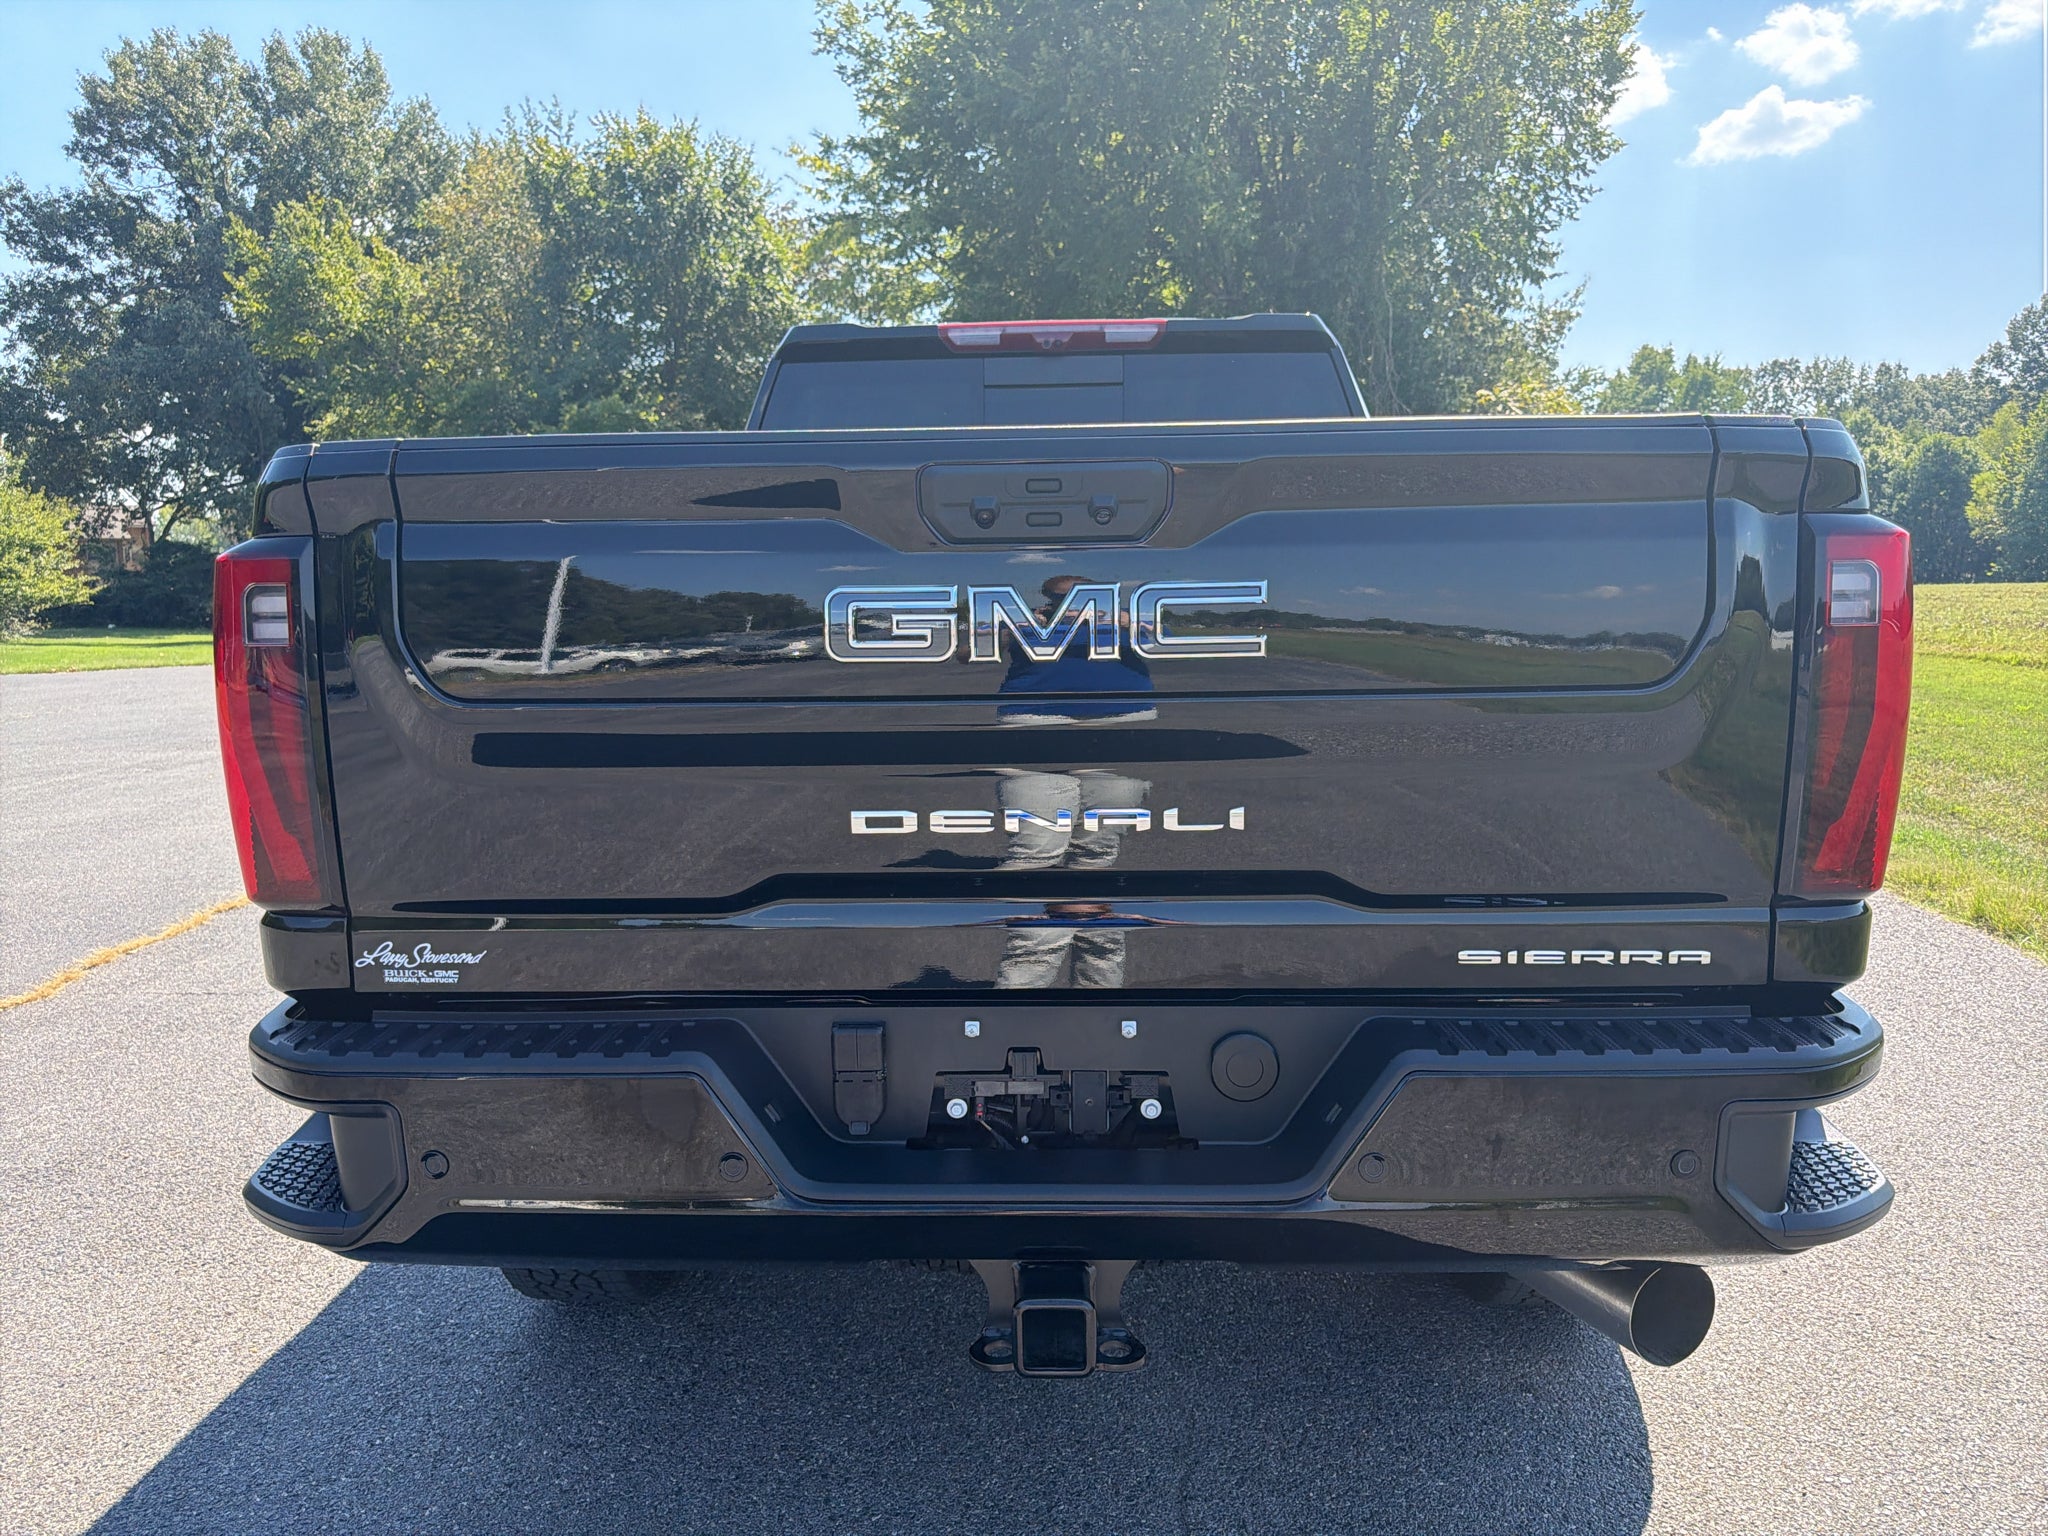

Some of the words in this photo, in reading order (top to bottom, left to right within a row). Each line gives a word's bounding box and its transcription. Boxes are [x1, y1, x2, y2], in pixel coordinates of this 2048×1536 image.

[824, 579, 1268, 664] GMC
[850, 806, 1246, 834] DENALI
[354, 941, 408, 968] Larry
[406, 943, 488, 968] Stovesand
[1457, 950, 1712, 966] SIERRA
[384, 969, 427, 978] BUICK
[433, 970, 460, 978] GMC
